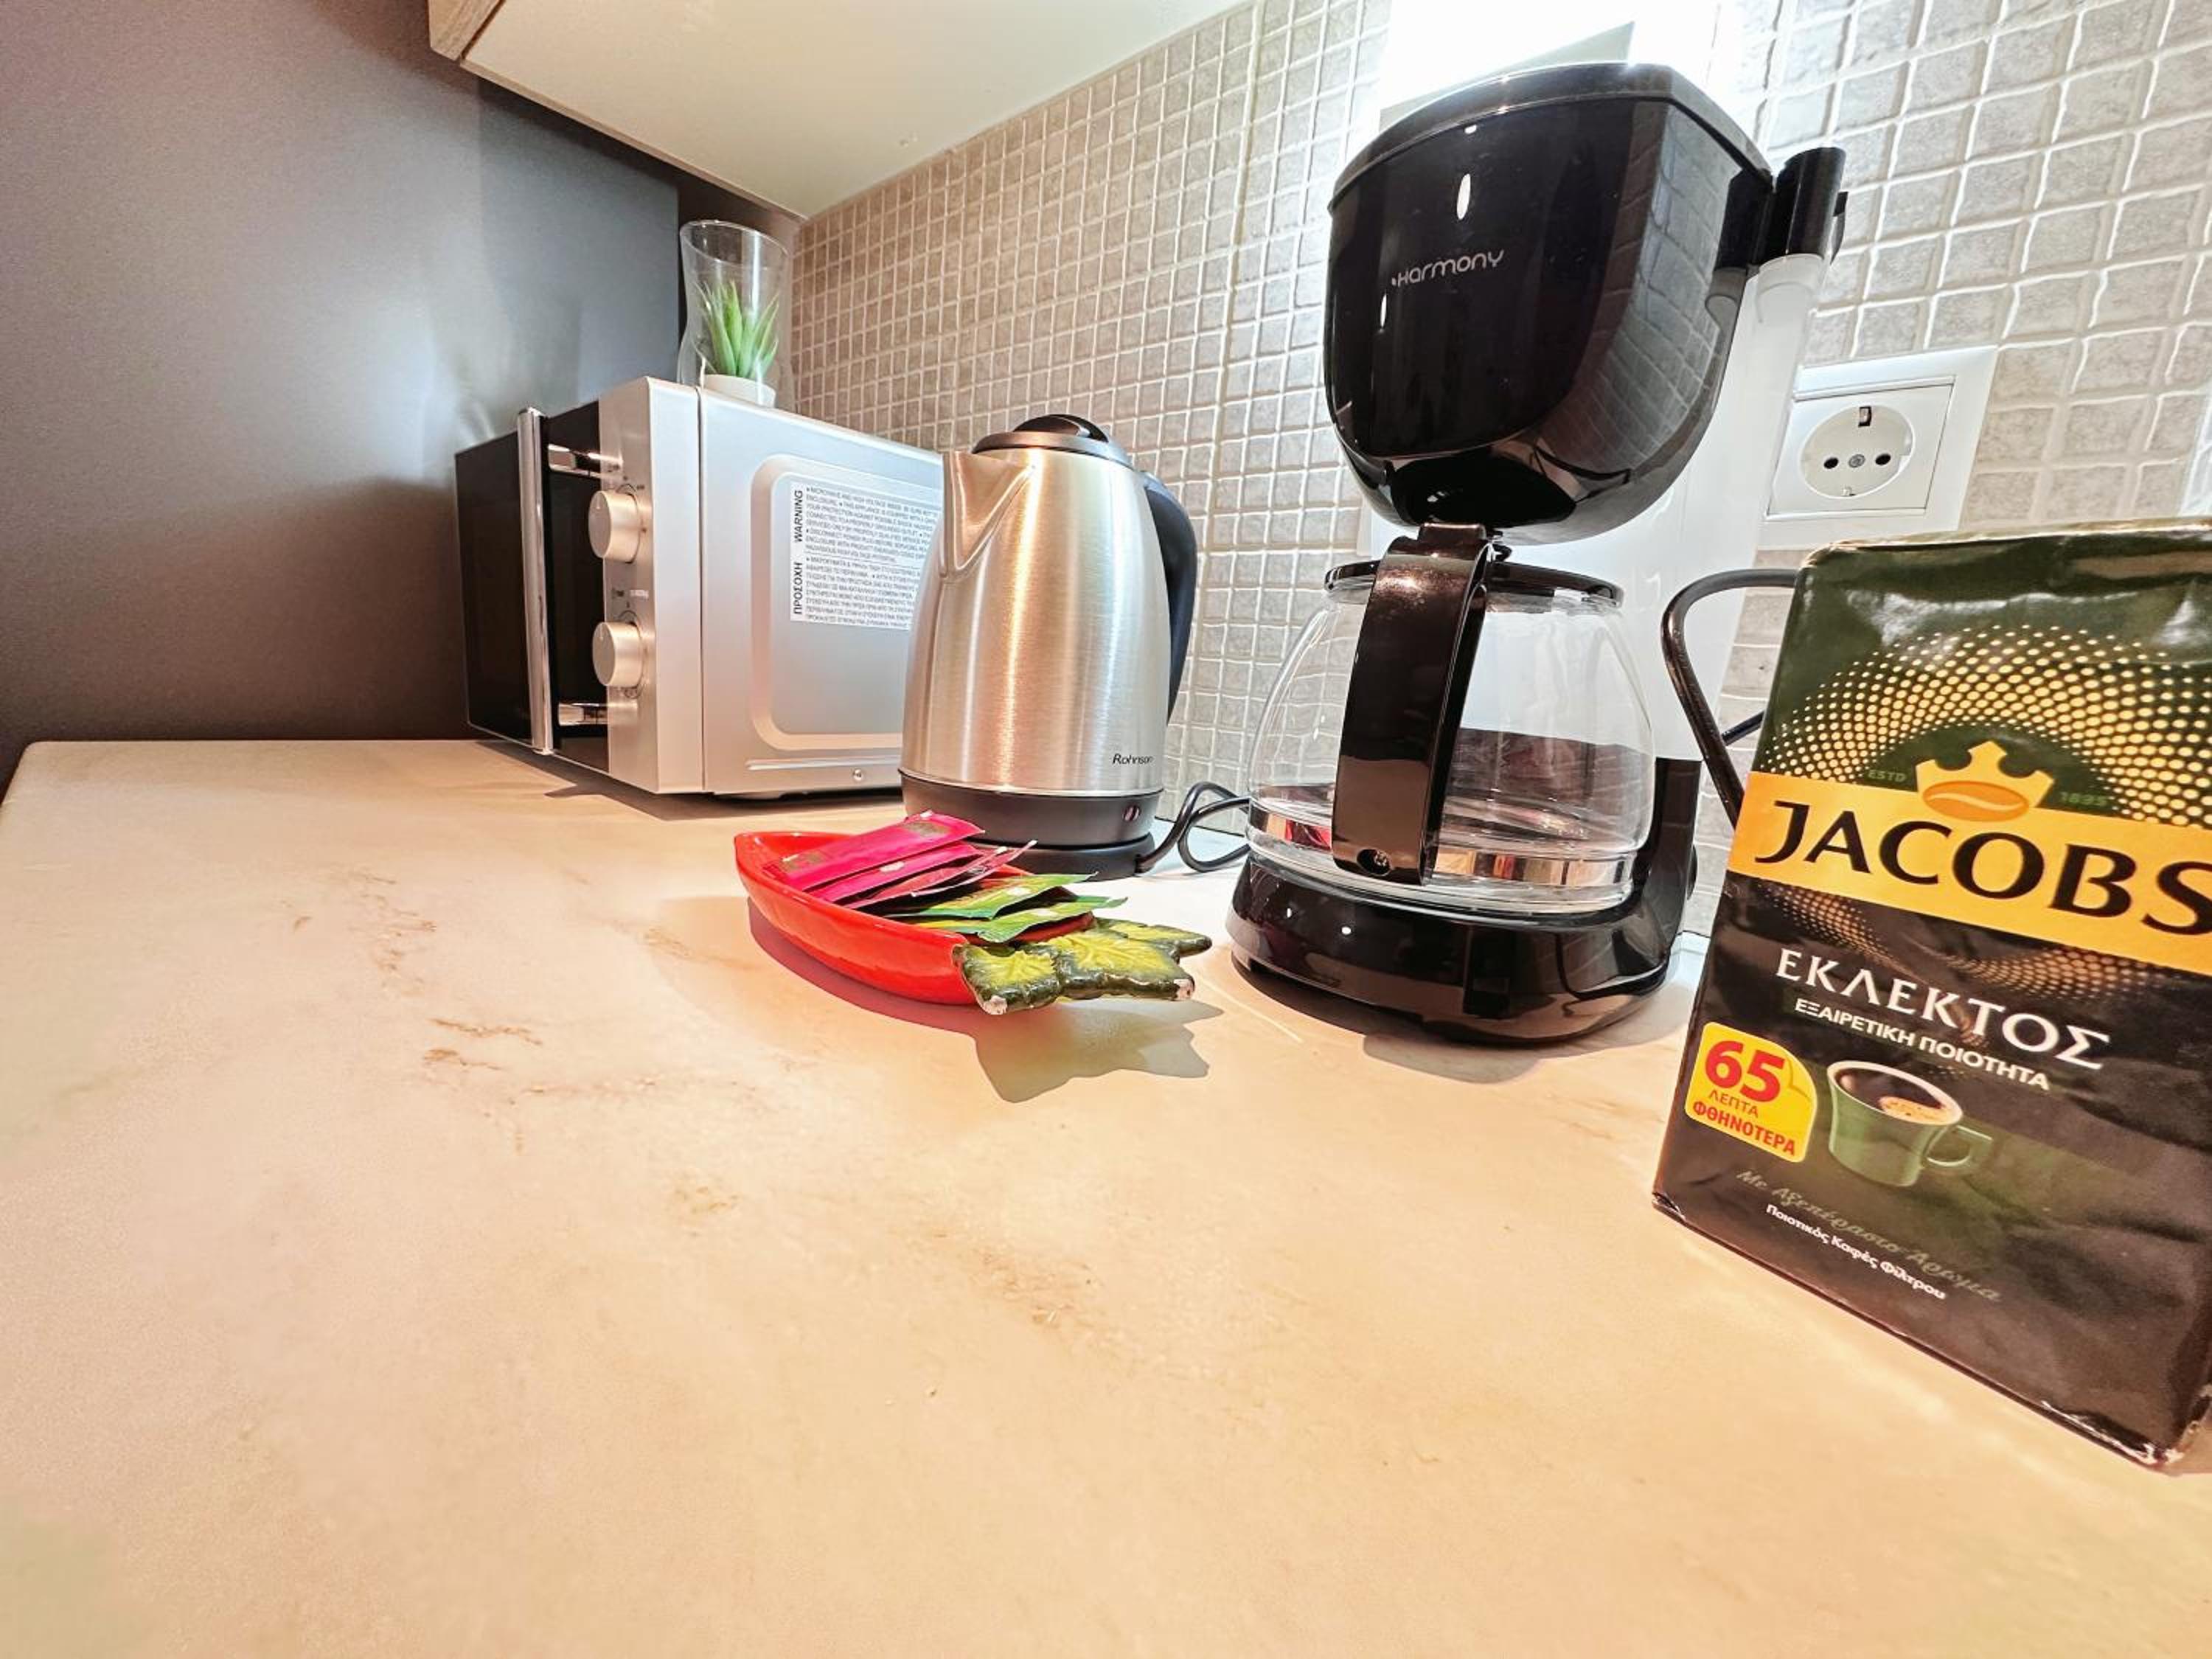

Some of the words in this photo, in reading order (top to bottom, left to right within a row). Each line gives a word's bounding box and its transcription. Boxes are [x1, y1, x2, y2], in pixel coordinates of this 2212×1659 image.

[794, 490, 804, 543] WARNING
[793, 561, 803, 615] ΠΡΟΣΟΧΗ
[1754, 800, 2212, 935] JACOBS
[1775, 947, 2110, 1070] ΕΚΛΕΚΤΟΣ
[1705, 1040, 1785, 1102] 65
[1794, 998, 1916, 1047] ΕΞΑΙΡΕΤΙΚΗ
[1917, 1036, 2051, 1091] ΠΟΙΟΤΗΤΑ
[1693, 1101, 1795, 1157] ΦΘΗΝΟΤΕΡΑ
[1708, 1089, 1759, 1118] ΛΕΠΤΑ
[1765, 1203, 1831, 1245] Ποιοτικός
